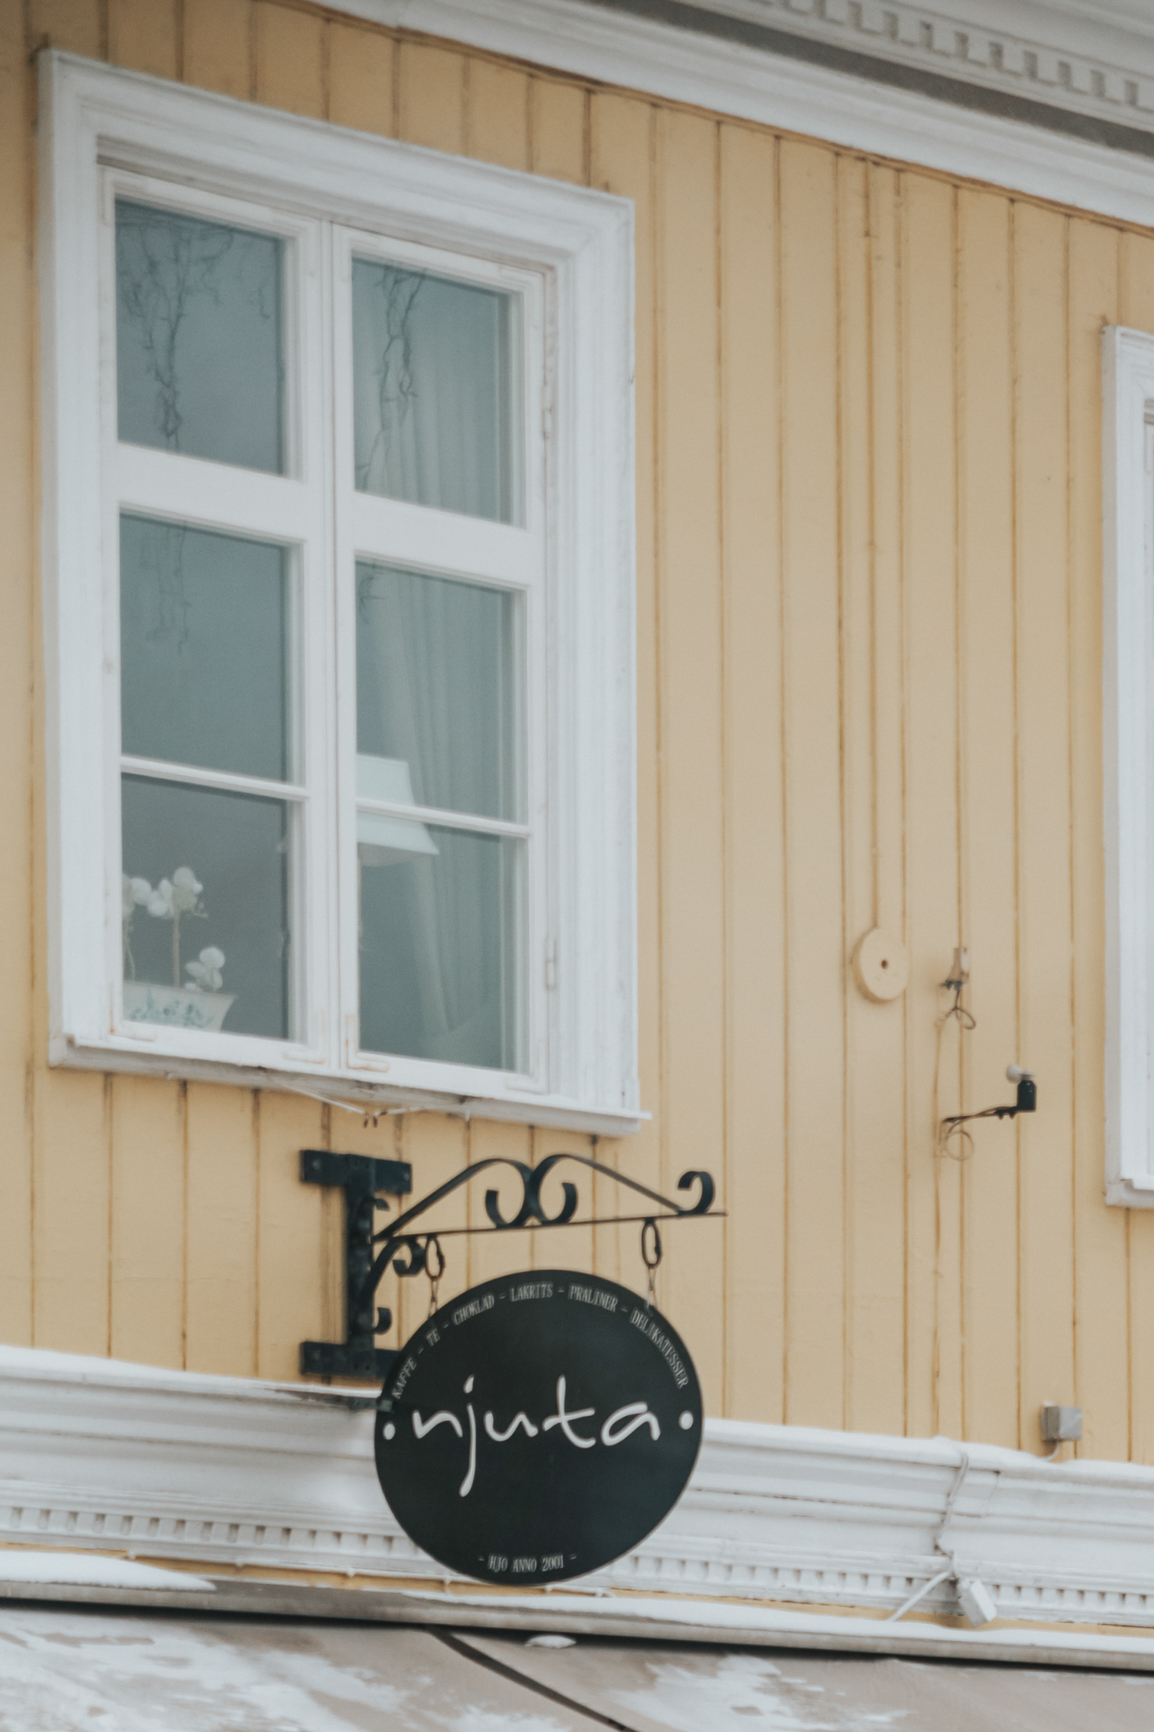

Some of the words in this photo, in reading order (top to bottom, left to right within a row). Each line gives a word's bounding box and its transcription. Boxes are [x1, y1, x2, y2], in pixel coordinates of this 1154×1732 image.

[391, 1357, 417, 1399] KAFFE
[426, 1328, 441, 1347] TE
[453, 1294, 495, 1325] CHOKLAD
[511, 1283, 553, 1302] LAKRITS
[569, 1285, 618, 1312] PRALINER
[630, 1309, 689, 1389] DELIKATESSER
[488, 1555, 509, 1572] HJO
[513, 1558, 537, 1572] ANNO
[542, 1555, 564, 1572] 2001
